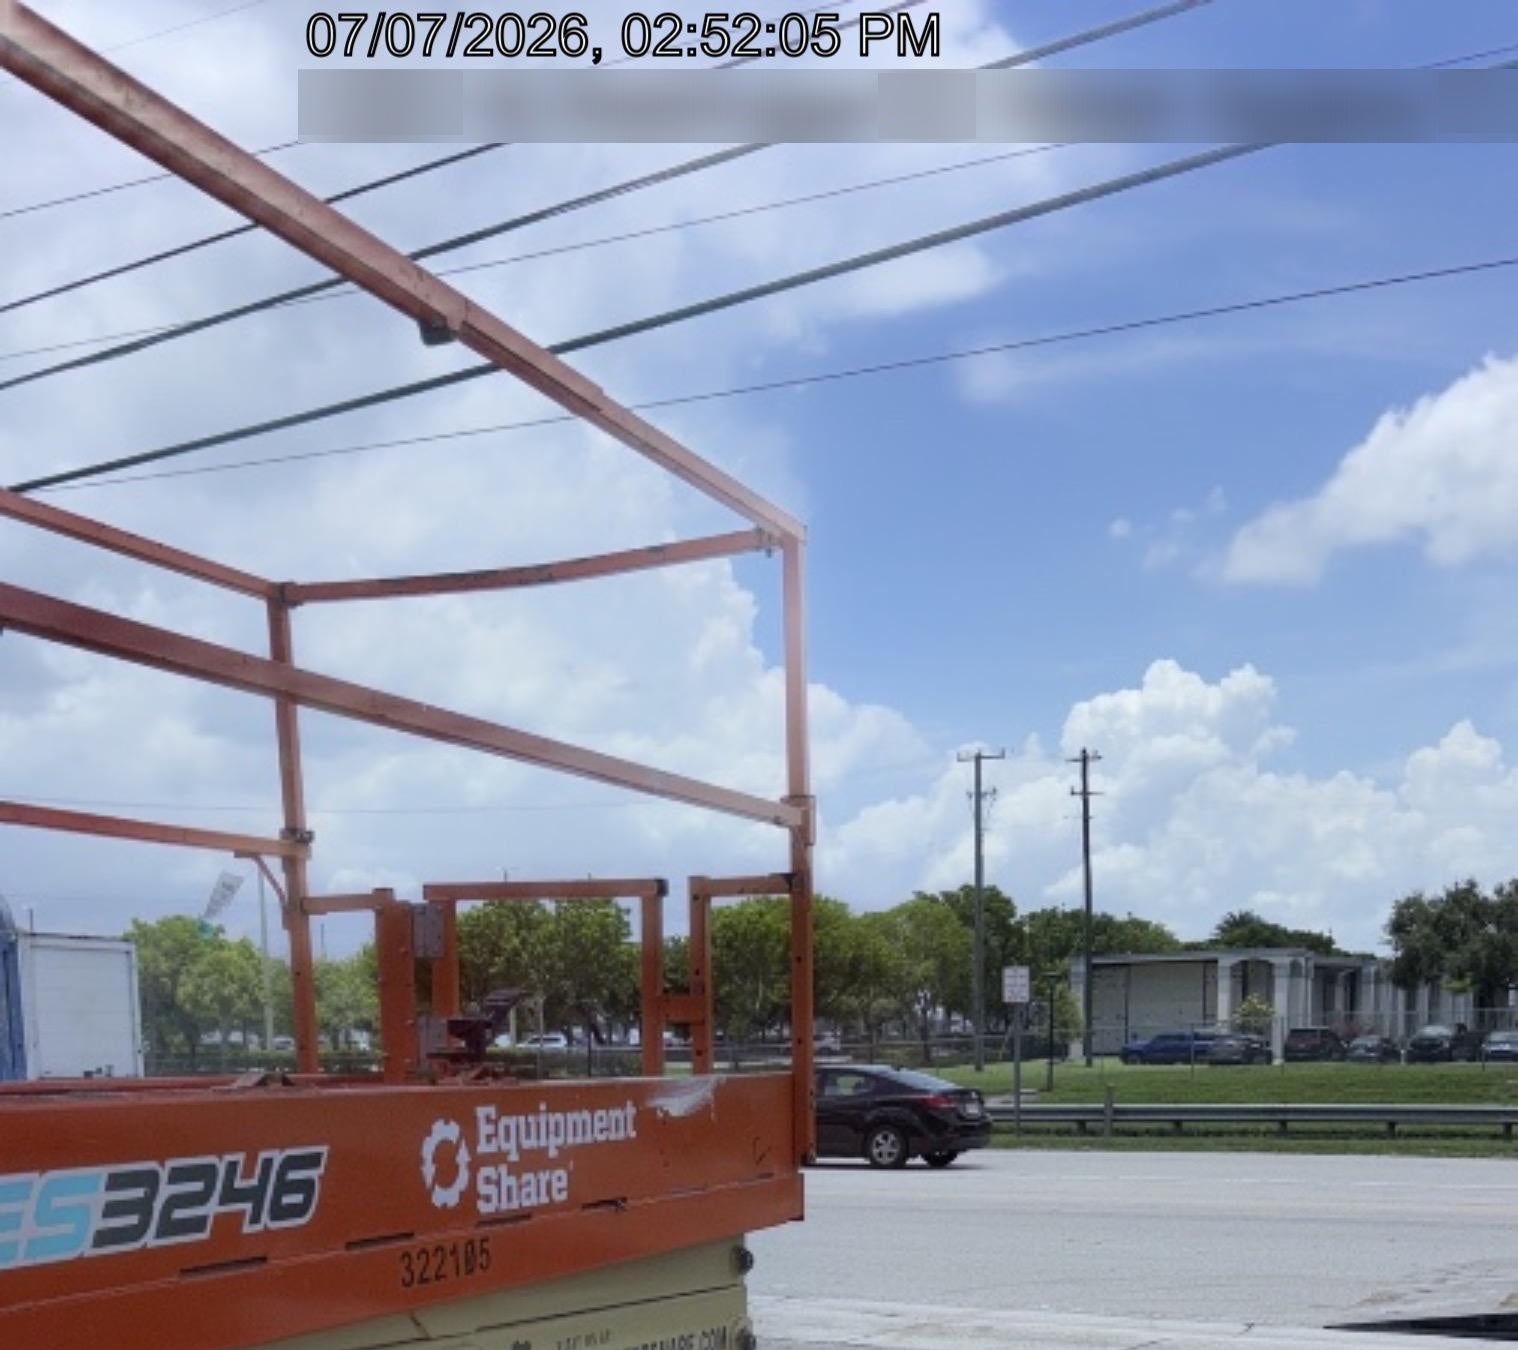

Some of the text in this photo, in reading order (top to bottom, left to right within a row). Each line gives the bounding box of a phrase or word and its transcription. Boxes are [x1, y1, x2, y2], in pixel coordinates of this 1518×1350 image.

[475, 1100, 637, 1162] Equipment
[476, 1163, 569, 1213] Share
[401, 1237, 490, 1288] 322105
